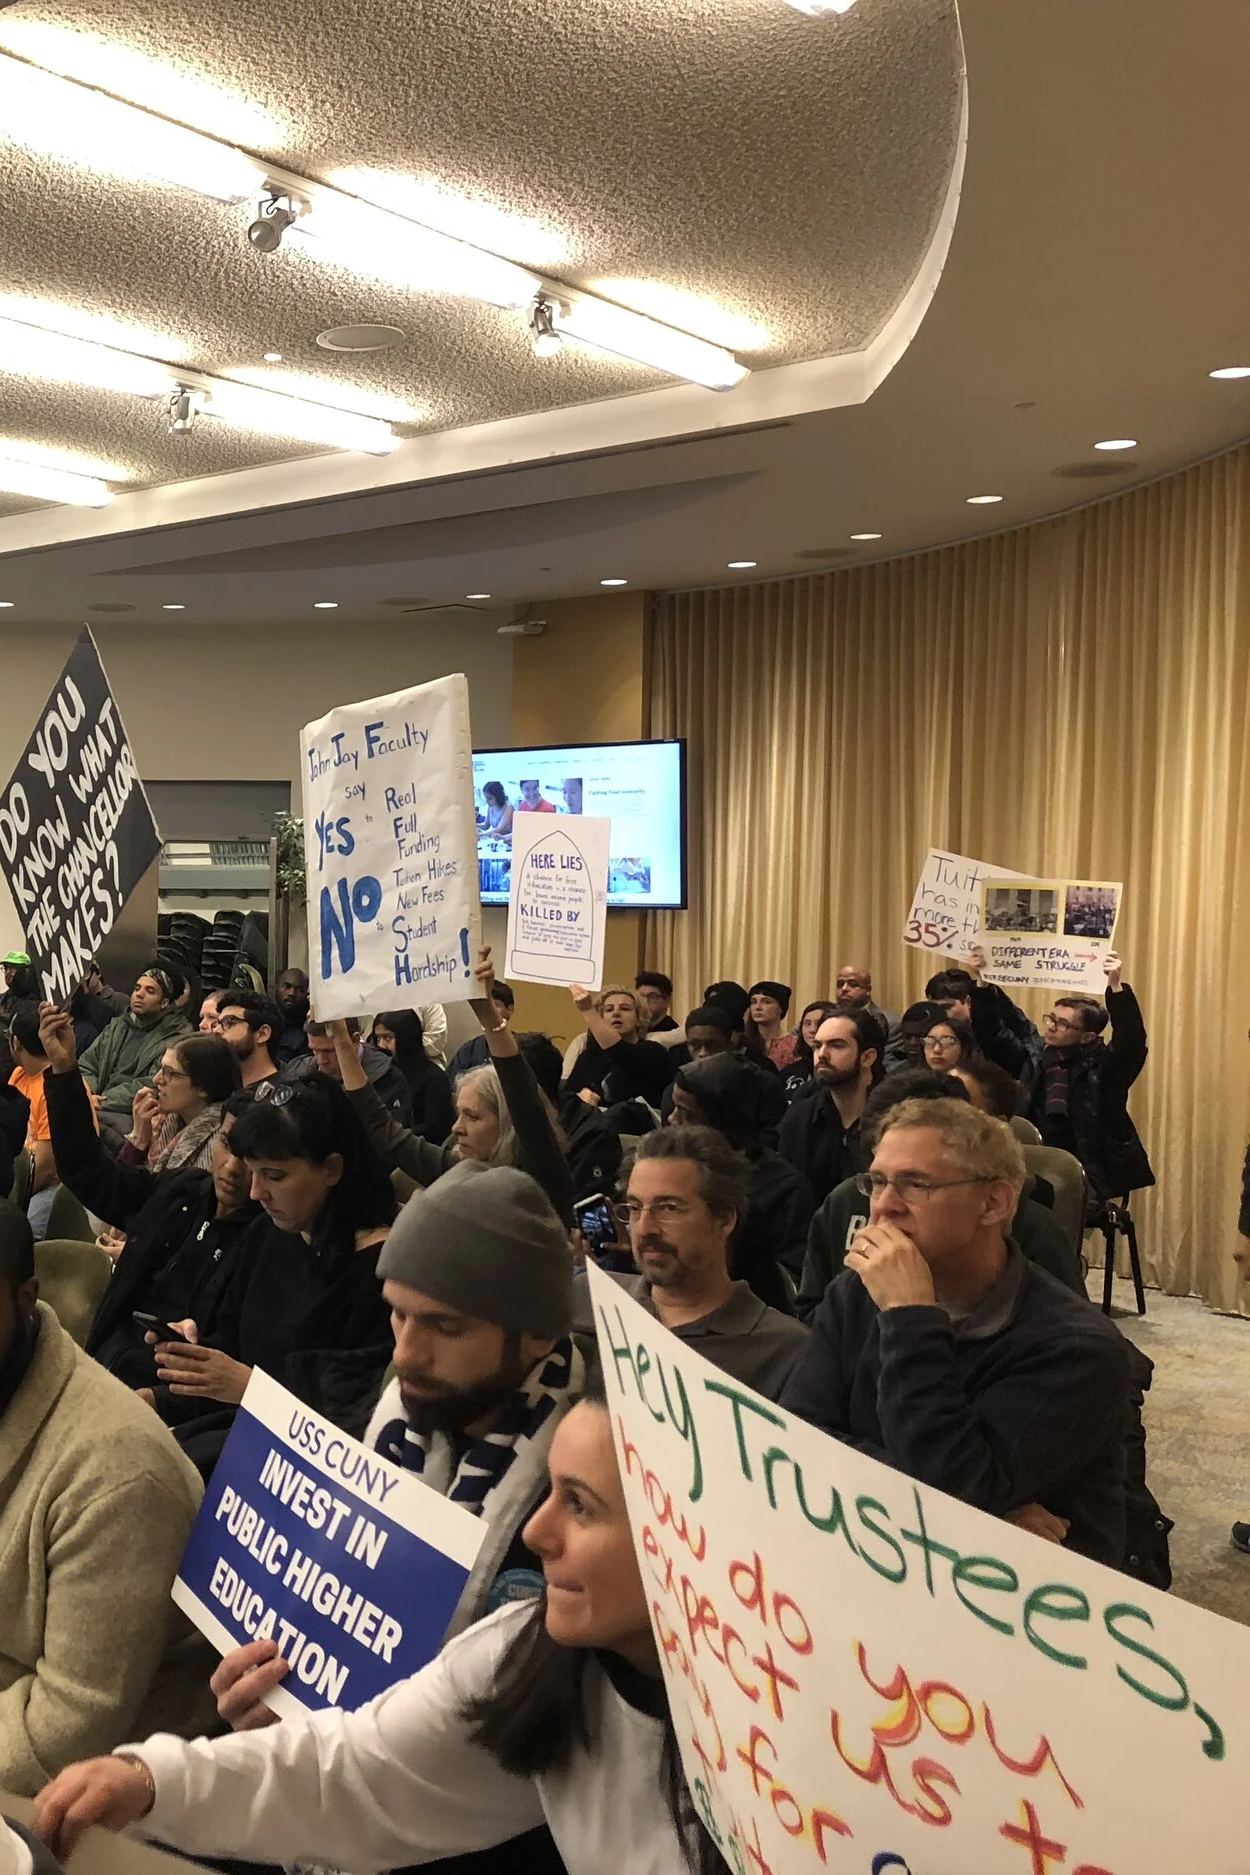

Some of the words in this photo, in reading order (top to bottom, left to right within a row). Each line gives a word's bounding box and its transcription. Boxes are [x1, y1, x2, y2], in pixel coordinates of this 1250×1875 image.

[28, 675, 86, 789] YOU
[308, 747, 330, 782] John
[331, 732, 358, 770] Jay
[364, 721, 428, 760] Faculty
[12, 794, 71, 914] KNOW
[69, 697, 119, 804] WHAT
[344, 781, 366, 800] say
[384, 782, 417, 813] Real
[314, 810, 355, 872] YES
[393, 812, 417, 839] Full
[27, 885, 61, 957] THE
[57, 743, 137, 910] CHANCELLOR
[397, 832, 440, 861] Funding
[530, 853, 555, 869] HERE
[560, 854, 583, 871] LIES
[393, 868, 421, 888] Tuition
[427, 858, 458, 881] Hikes
[932, 855, 982, 892] Tuit
[396, 893, 418, 911] New
[421, 885, 445, 903] Fees
[520, 904, 562, 921] KILLED
[567, 910, 581, 922] BY
[922, 882, 958, 908] has
[40, 840, 124, 1006] MAKES?
[392, 915, 437, 953] Student
[903, 920, 959, 949] 35%
[914, 906, 956, 928] more
[991, 946, 1048, 958] DIFFERENT
[1049, 947, 1070, 959] ERA
[993, 959, 1022, 969] SAME
[1035, 960, 1086, 972] STRUGGLE
[288, 1410, 326, 1456] USS
[324, 1440, 400, 1503] CUNY
[258, 1448, 351, 1541] INVEST
[344, 1514, 388, 1570] IN
[599, 1305, 702, 1503] Hey
[704, 1378, 1225, 1761] Trustees,
[214, 1485, 289, 1575] PUBLIC
[282, 1548, 403, 1664] HIGHER
[208, 1556, 350, 1705] EDUCATION
[617, 1414, 706, 1563] how
[729, 1550, 815, 1656] do
[853, 1637, 1085, 1809] you
[642, 1524, 800, 1722] expect
[830, 1706, 963, 1826] us
[736, 1724, 853, 1866] for
